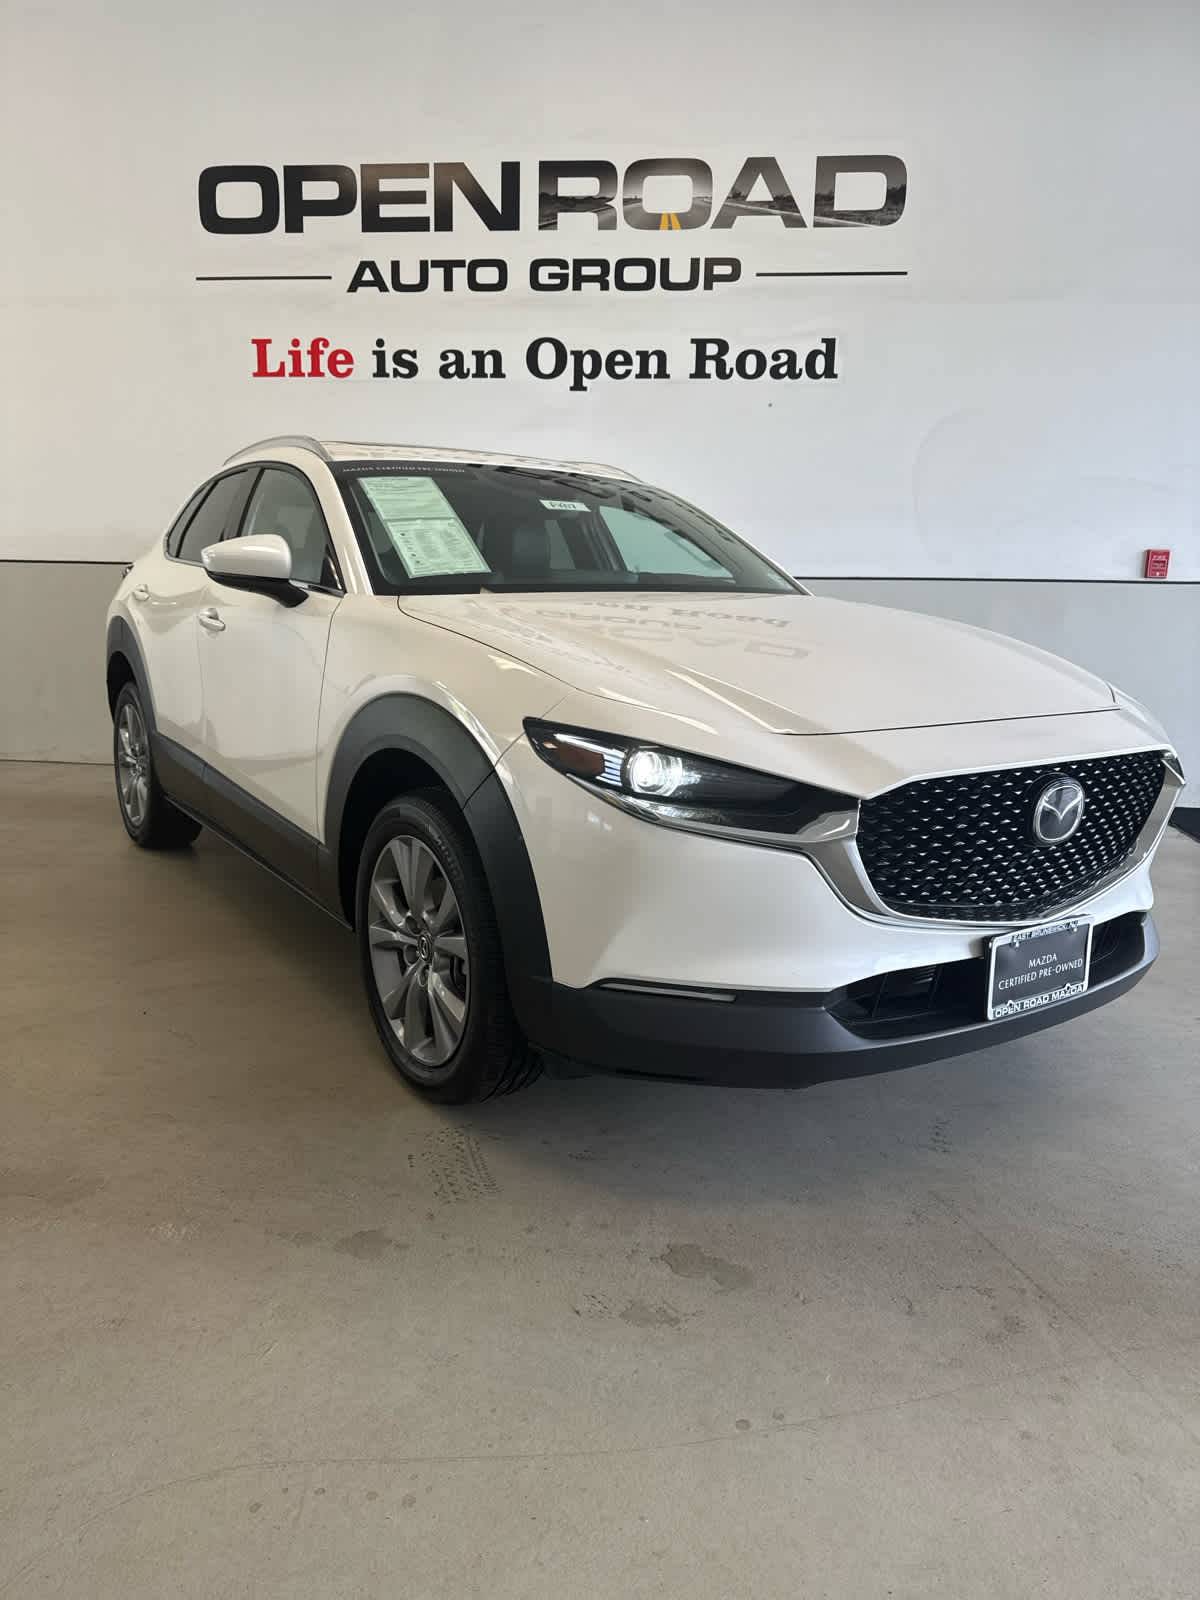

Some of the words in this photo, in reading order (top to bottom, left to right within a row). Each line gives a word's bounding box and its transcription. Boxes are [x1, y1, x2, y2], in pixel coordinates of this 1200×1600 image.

[198, 161, 520, 234] OPEN
[538, 155, 908, 231] ROAD
[346, 258, 508, 293] AUTO
[529, 257, 742, 292] GROUP
[251, 337, 355, 379] Life
[372, 338, 419, 379] is
[438, 348, 506, 380] an
[525, 337, 671, 392] Open
[688, 337, 838, 380] Road
[998, 971, 1037, 990] CERTIFIED
[1039, 958, 1083, 979] PRE-OWNED
[1028, 953, 1057, 968] MAZDA
[995, 1001, 1020, 1018] OPEN
[1024, 995, 1049, 1010] ROAD
[1051, 985, 1083, 1001] MAZDA
